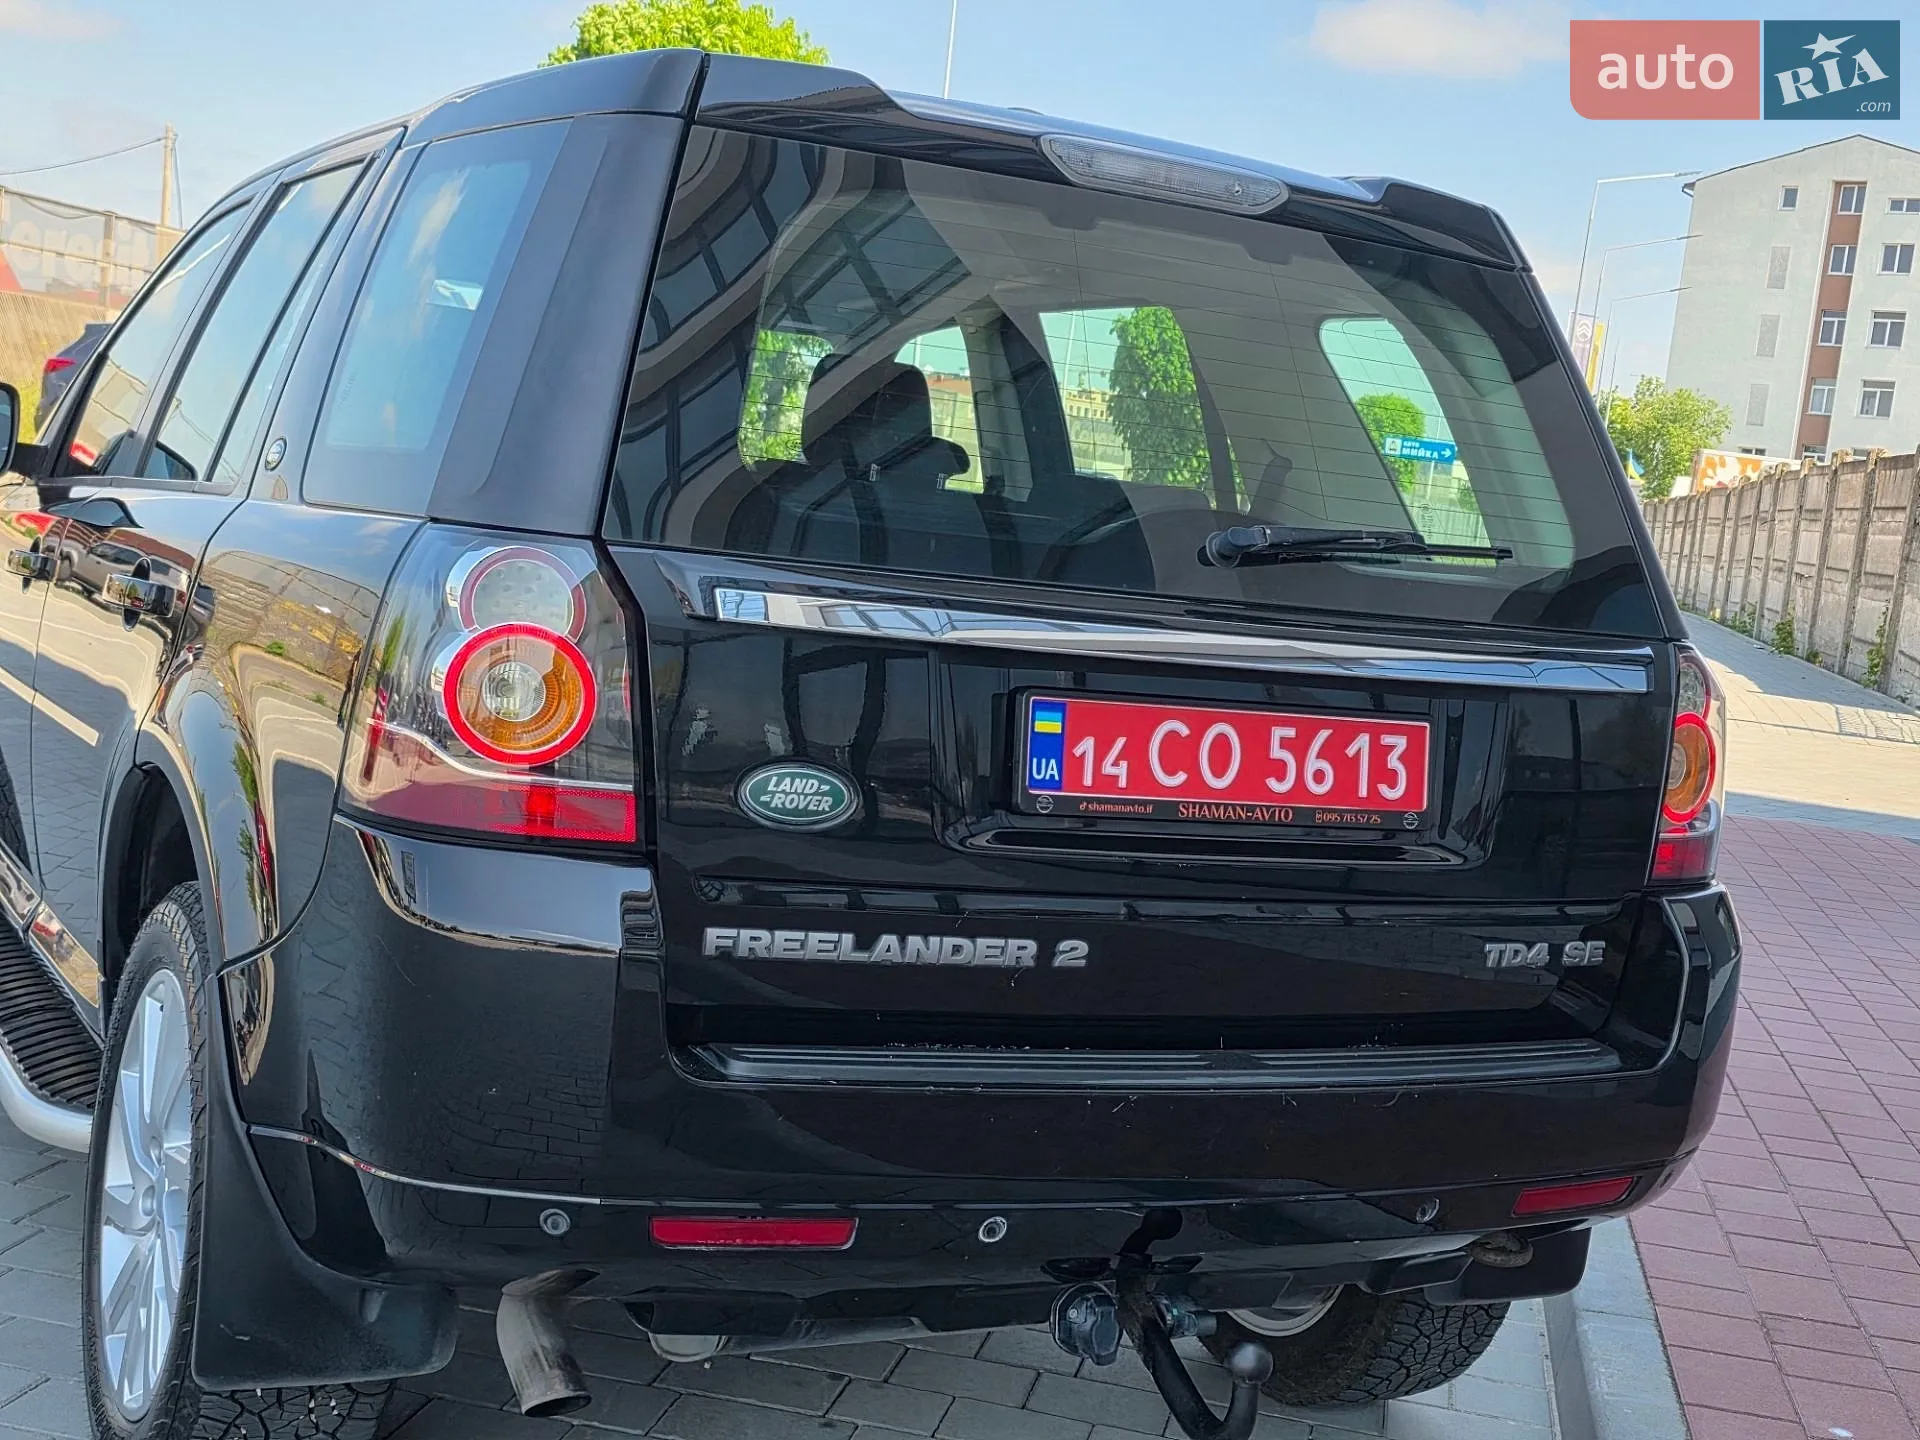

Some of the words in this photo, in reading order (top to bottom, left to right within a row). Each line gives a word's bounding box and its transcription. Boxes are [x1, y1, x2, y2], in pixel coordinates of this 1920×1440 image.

[1032, 757, 1059, 781] UA
[1072, 735, 1128, 789] 14
[1149, 719, 1242, 790] CO
[1265, 726, 1409, 802] 5613
[768, 776, 818, 794] LAND
[770, 793, 833, 812] ROVER
[1178, 803, 1293, 823] SHAMAN-AVTO
[702, 926, 1038, 969] FREELANDER
[1051, 939, 1090, 969] 2
[1484, 942, 1550, 968] TD4
[1562, 940, 1606, 967] SE
